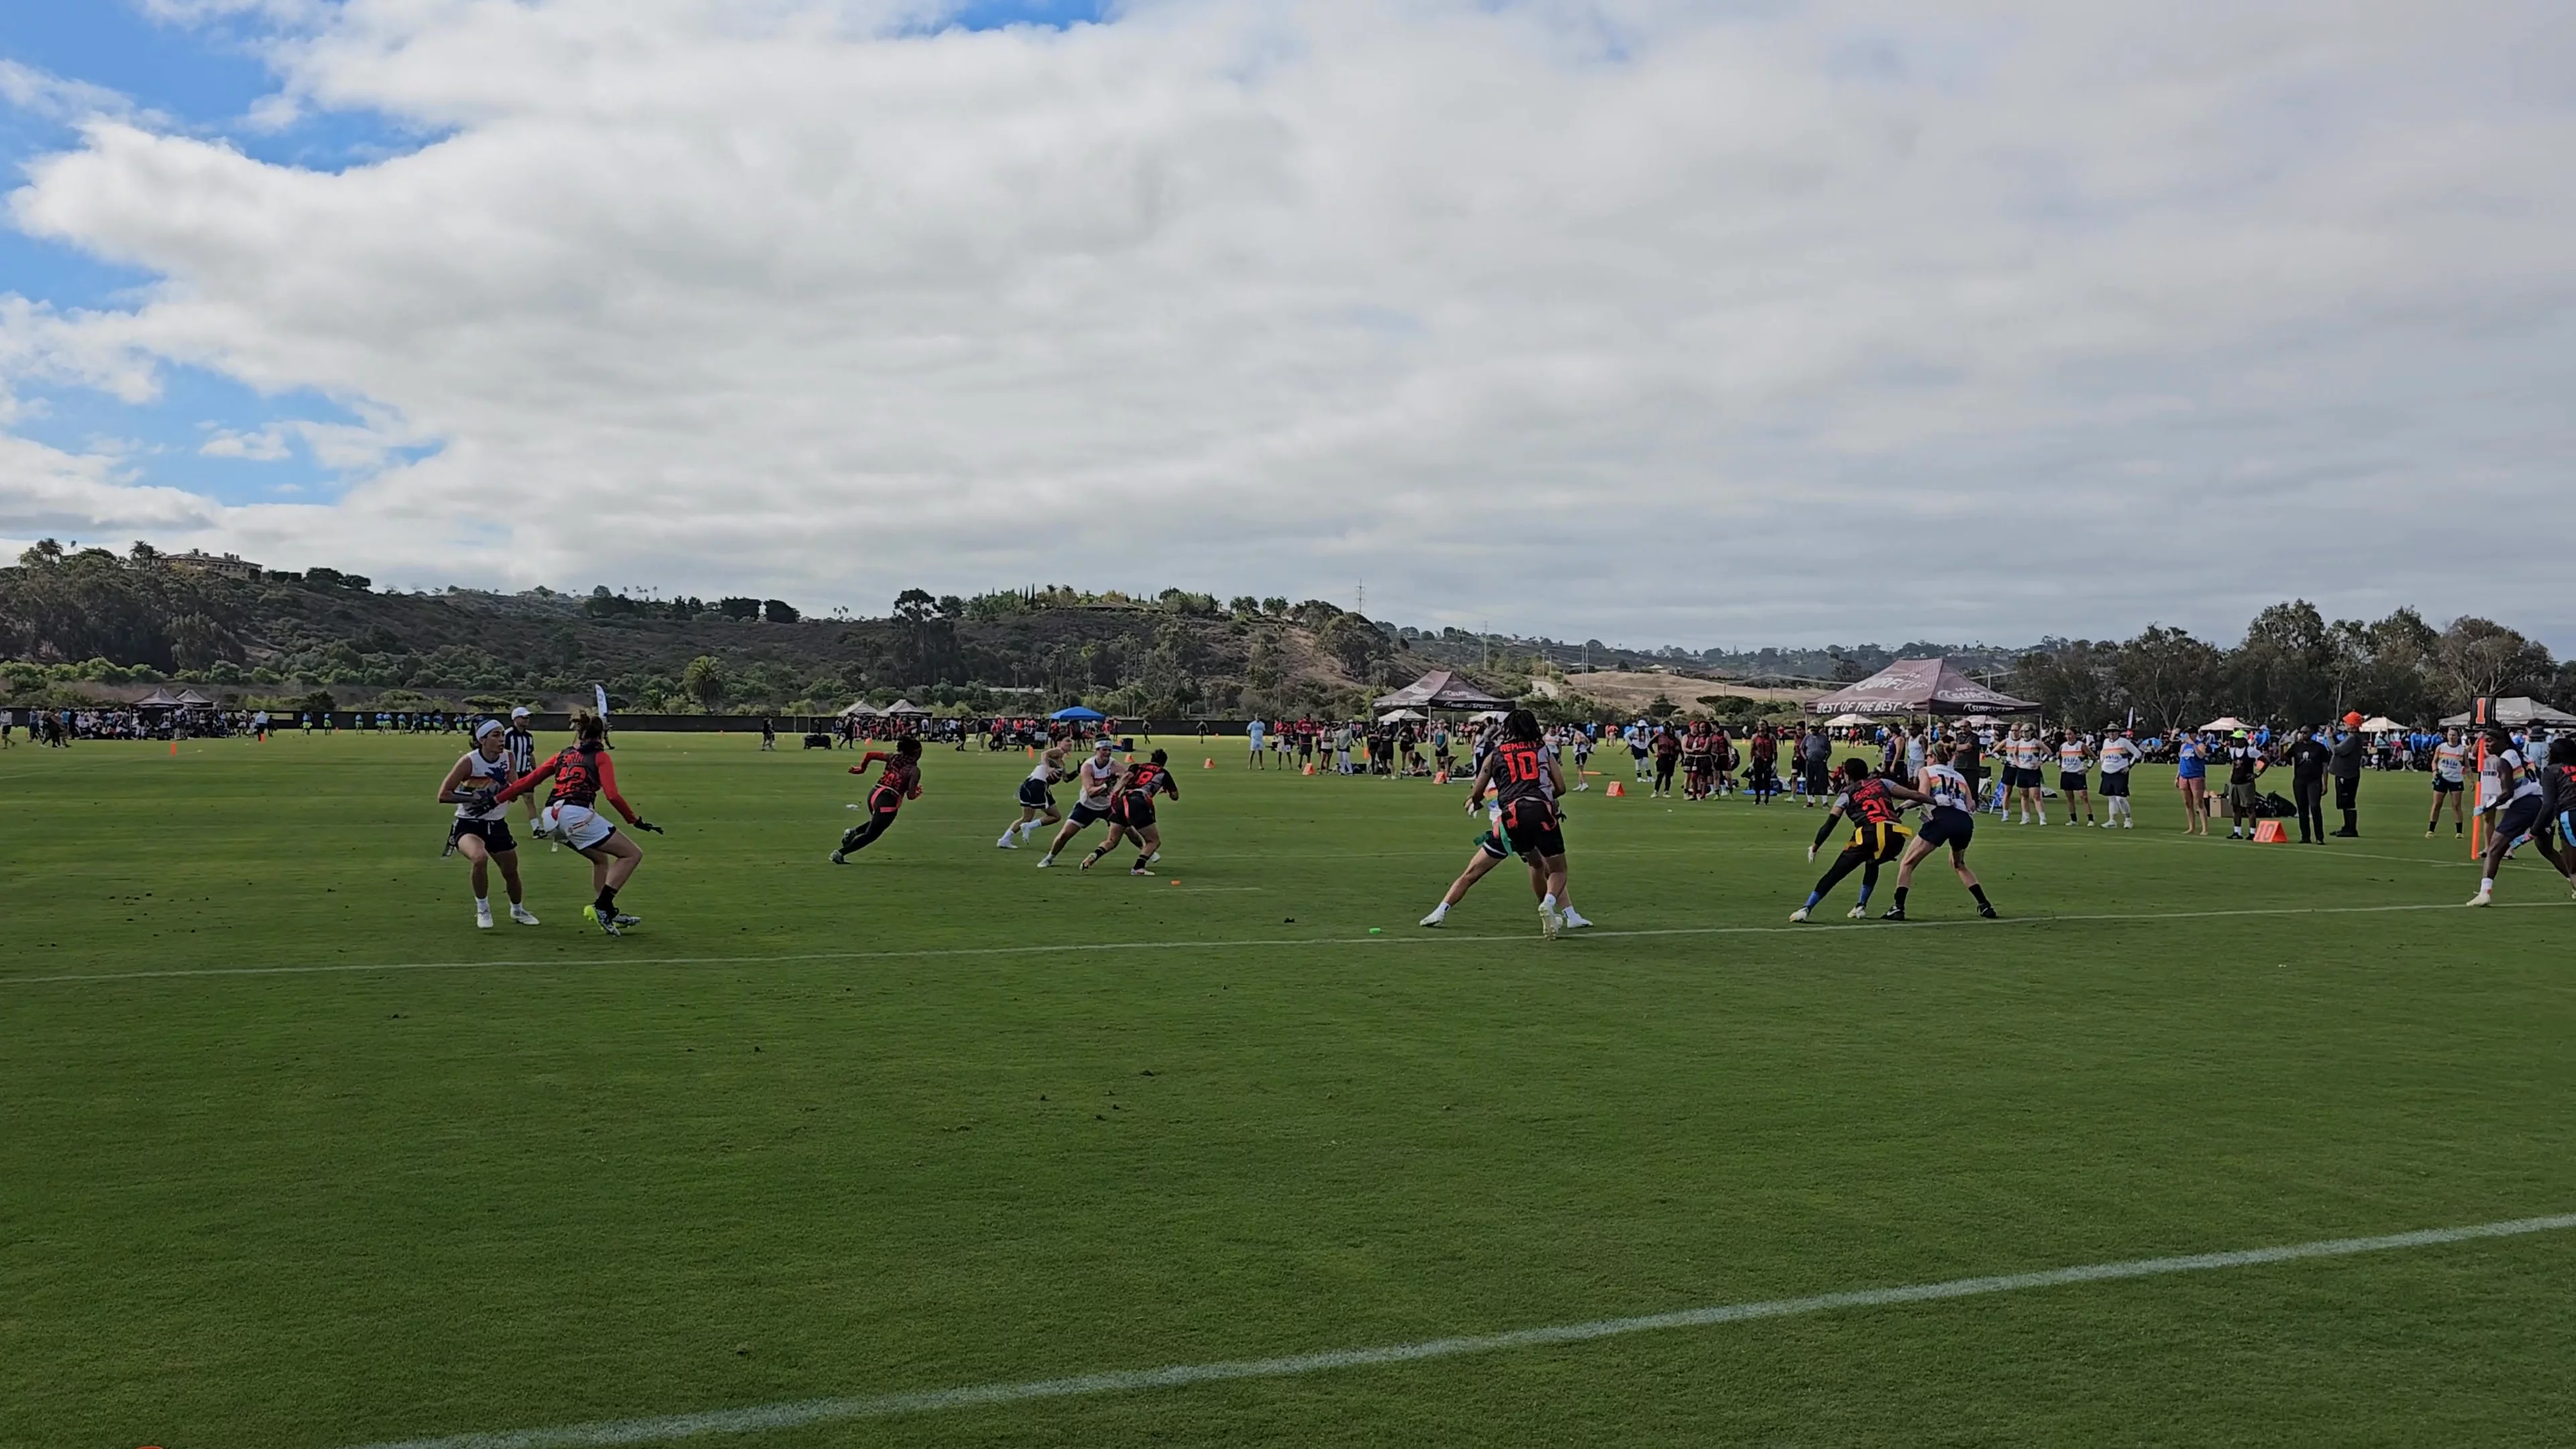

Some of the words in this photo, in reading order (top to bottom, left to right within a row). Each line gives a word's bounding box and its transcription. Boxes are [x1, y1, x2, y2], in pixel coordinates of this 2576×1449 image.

[1816, 702, 1841, 714] BEST
[1840, 702, 1856, 712] OF
[1855, 702, 1875, 712] THE
[1874, 701, 1902, 712] BEST
[2475, 697, 2486, 724] 1
[1503, 751, 1538, 784] 10
[1937, 773, 1961, 799] 14
[2256, 823, 2275, 841] 10
